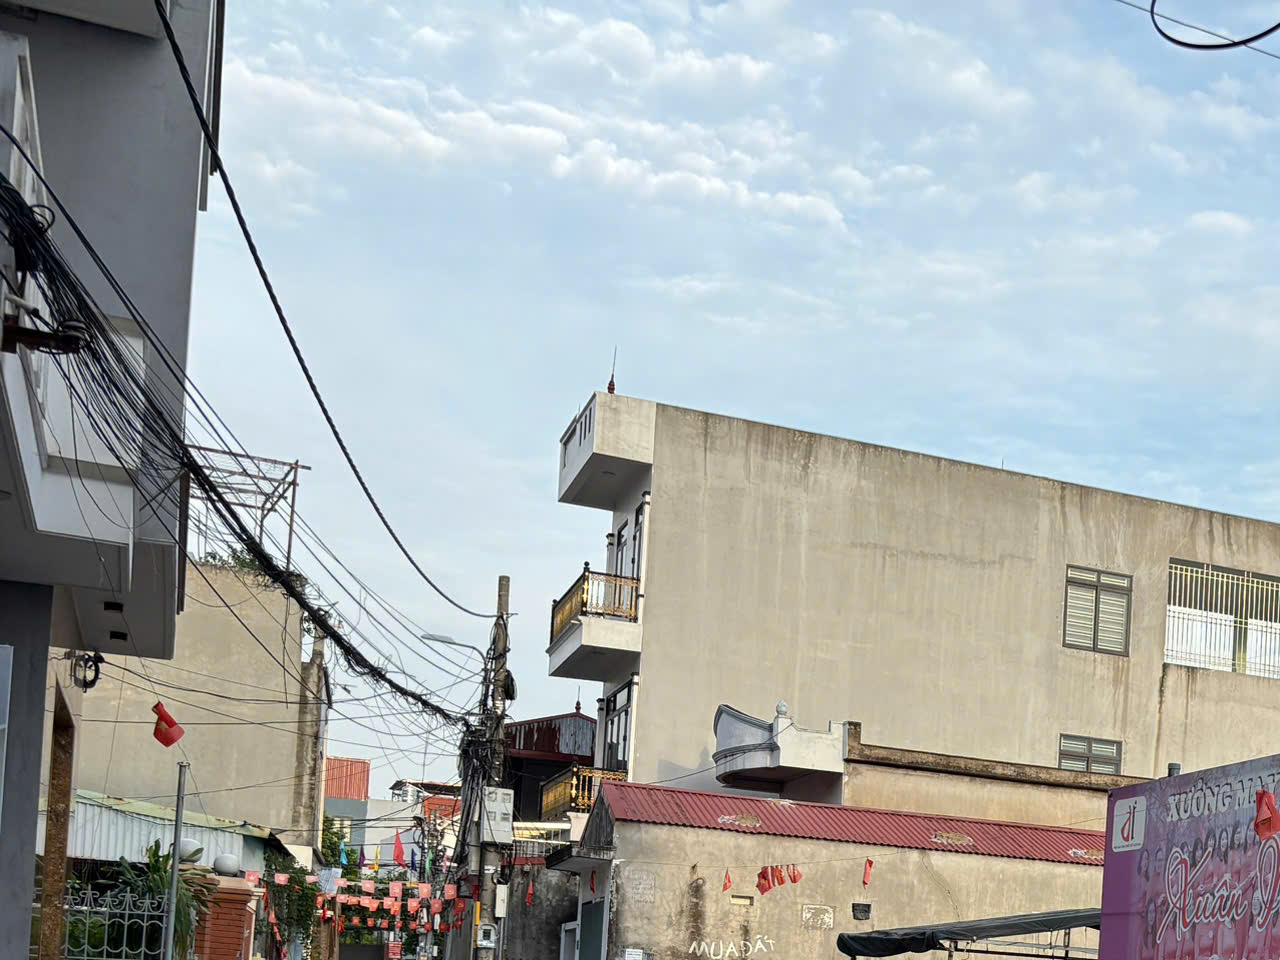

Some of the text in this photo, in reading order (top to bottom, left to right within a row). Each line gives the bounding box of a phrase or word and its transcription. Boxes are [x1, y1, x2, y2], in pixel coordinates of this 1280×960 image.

[1167, 777, 1232, 821] XƯỞNG
[1156, 848, 1248, 943] Xuân
[689, 934, 776, 959] MUA ĐẤT
